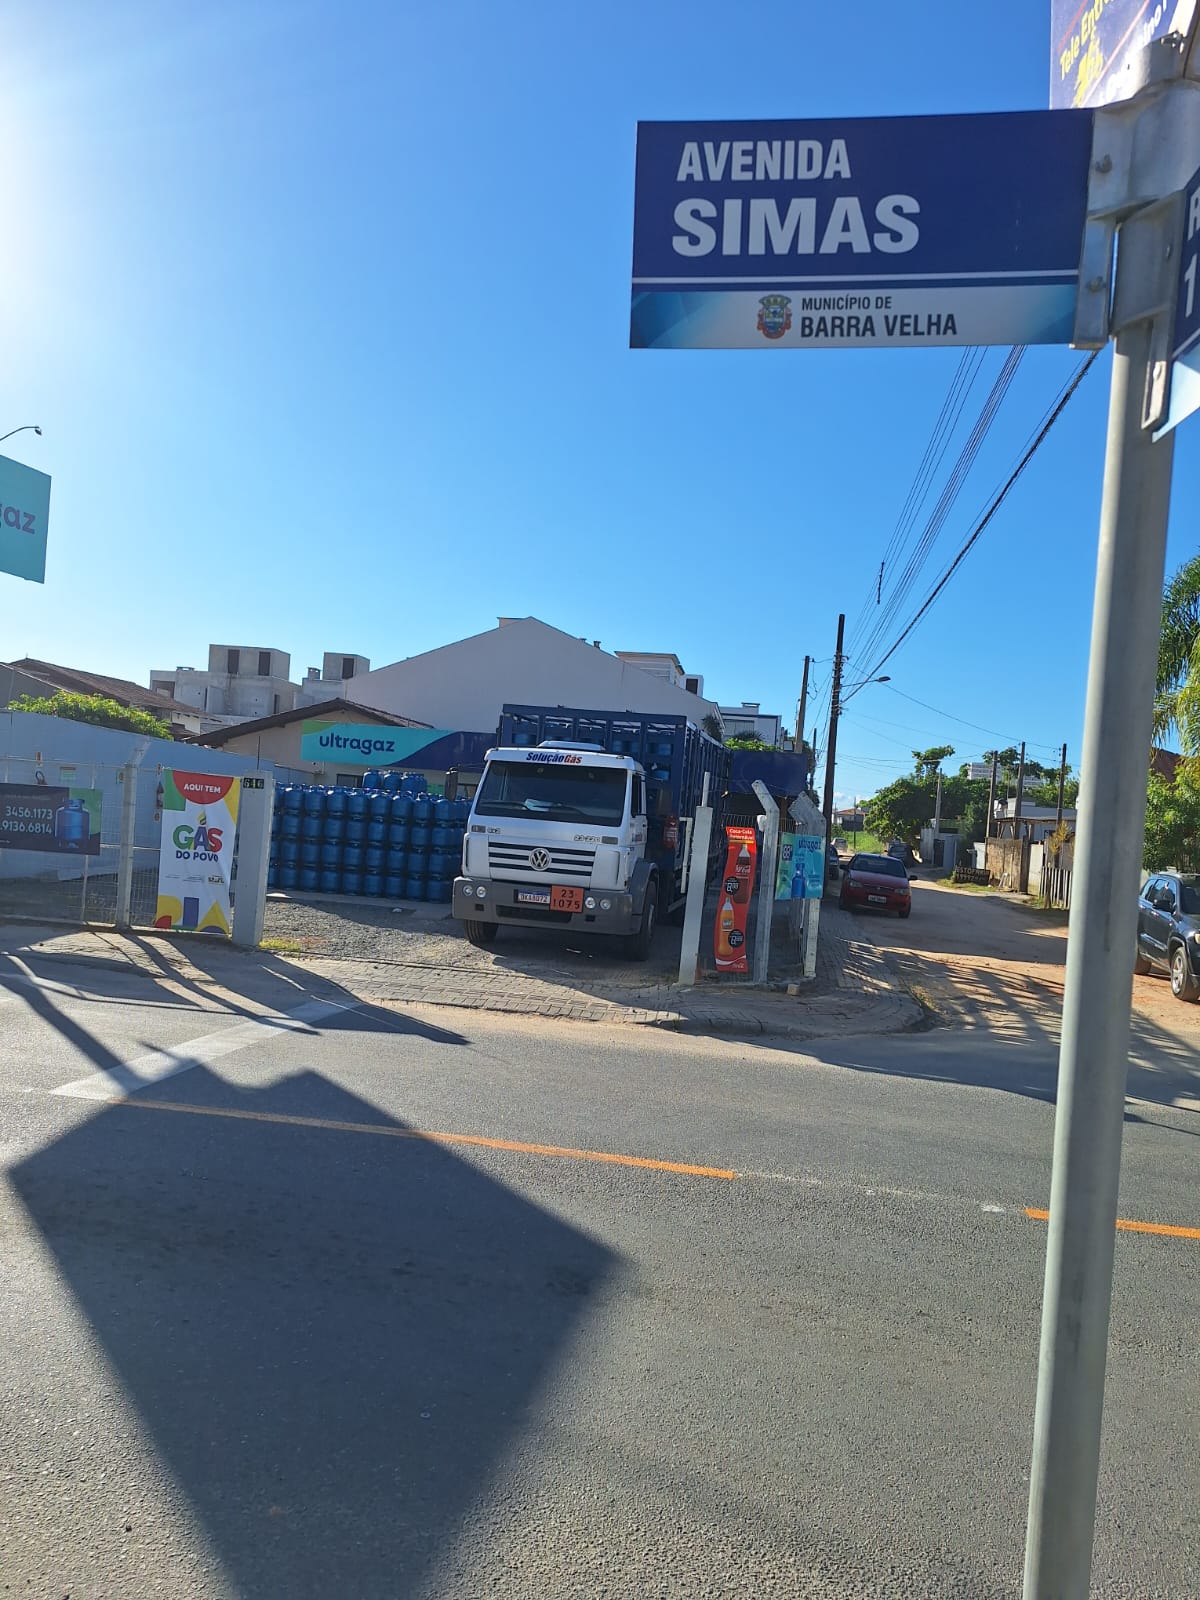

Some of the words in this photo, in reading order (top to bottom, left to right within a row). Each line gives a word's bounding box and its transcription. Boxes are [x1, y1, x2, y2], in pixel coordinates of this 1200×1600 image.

[676, 138, 851, 182] AVENIDA
[672, 194, 921, 257] SIMAS
[801, 293, 870, 311] MUNICÍPIO
[875, 296, 892, 310] DE
[801, 315, 875, 338] BARRA
[885, 313, 957, 336] VELHA
[0, 504, 36, 535] az
[319, 732, 395, 755] ultragaz
[184, 783, 203, 792] AQUI
[205, 785, 221, 794] TEM
[5, 805, 53, 820] 3456.1173
[176, 850, 190, 860] DO
[193, 851, 219, 862] POVO
[561, 889, 574, 898] 23
[553, 898, 580, 909] 1075
